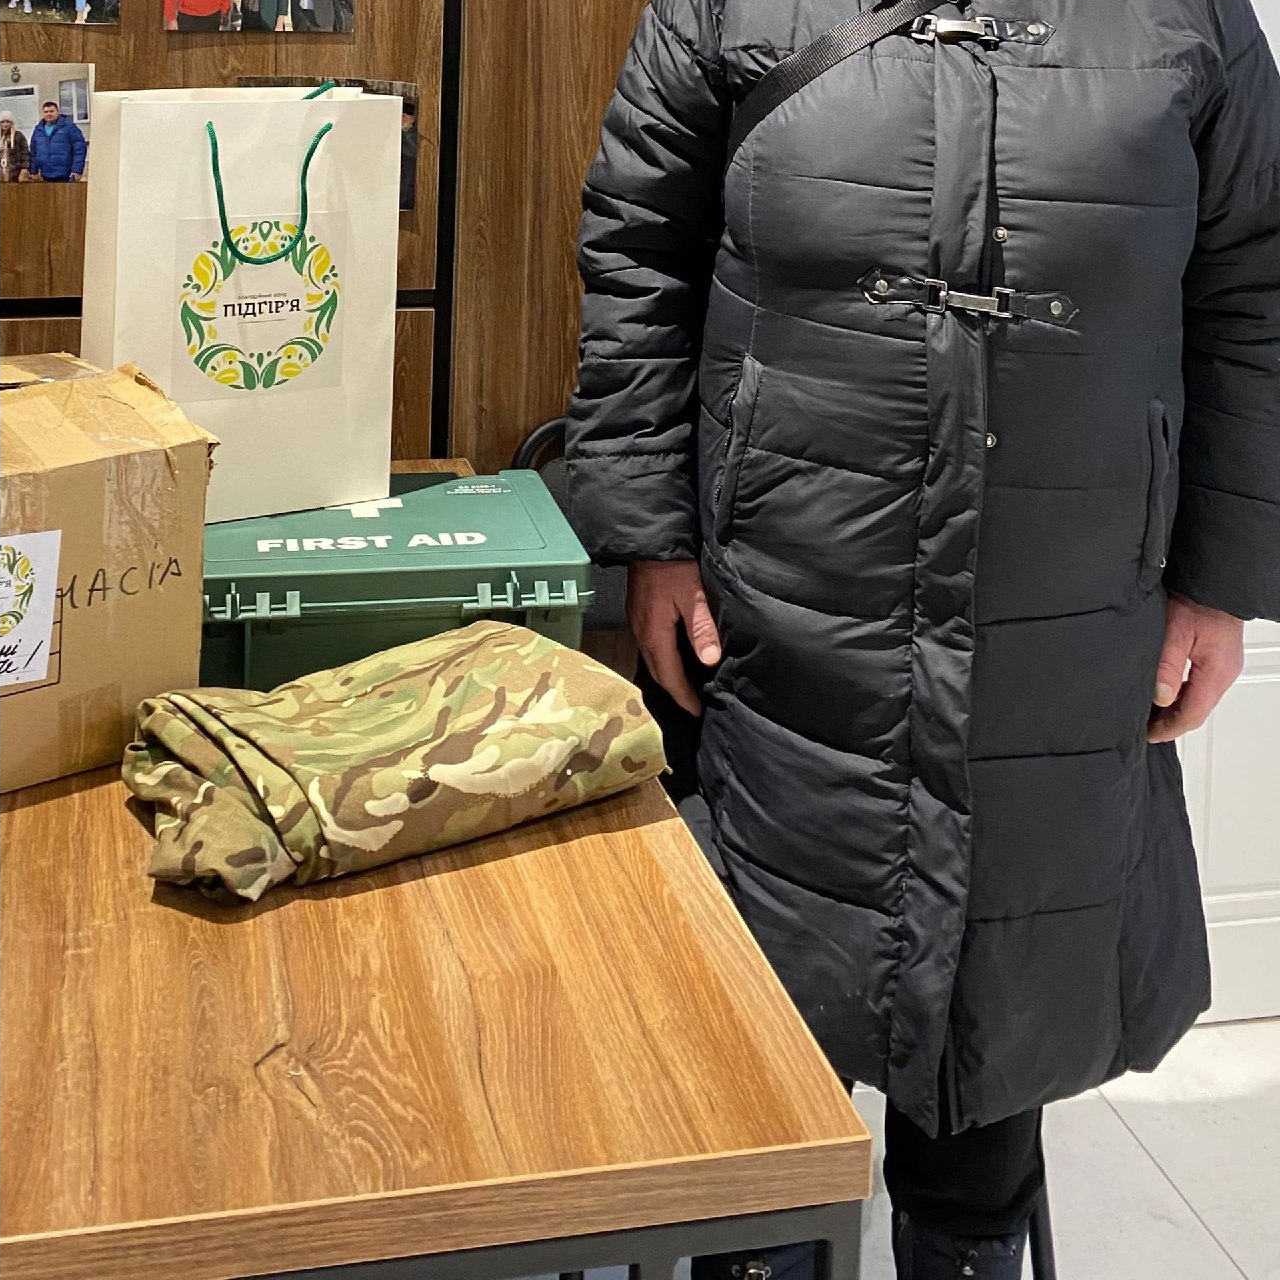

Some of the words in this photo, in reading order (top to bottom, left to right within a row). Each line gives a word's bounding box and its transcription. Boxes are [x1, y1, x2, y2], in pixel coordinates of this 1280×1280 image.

[222, 298, 301, 319] ПІДГІР'Я
[256, 535, 393, 553] FIRST
[407, 531, 487, 548] AID
